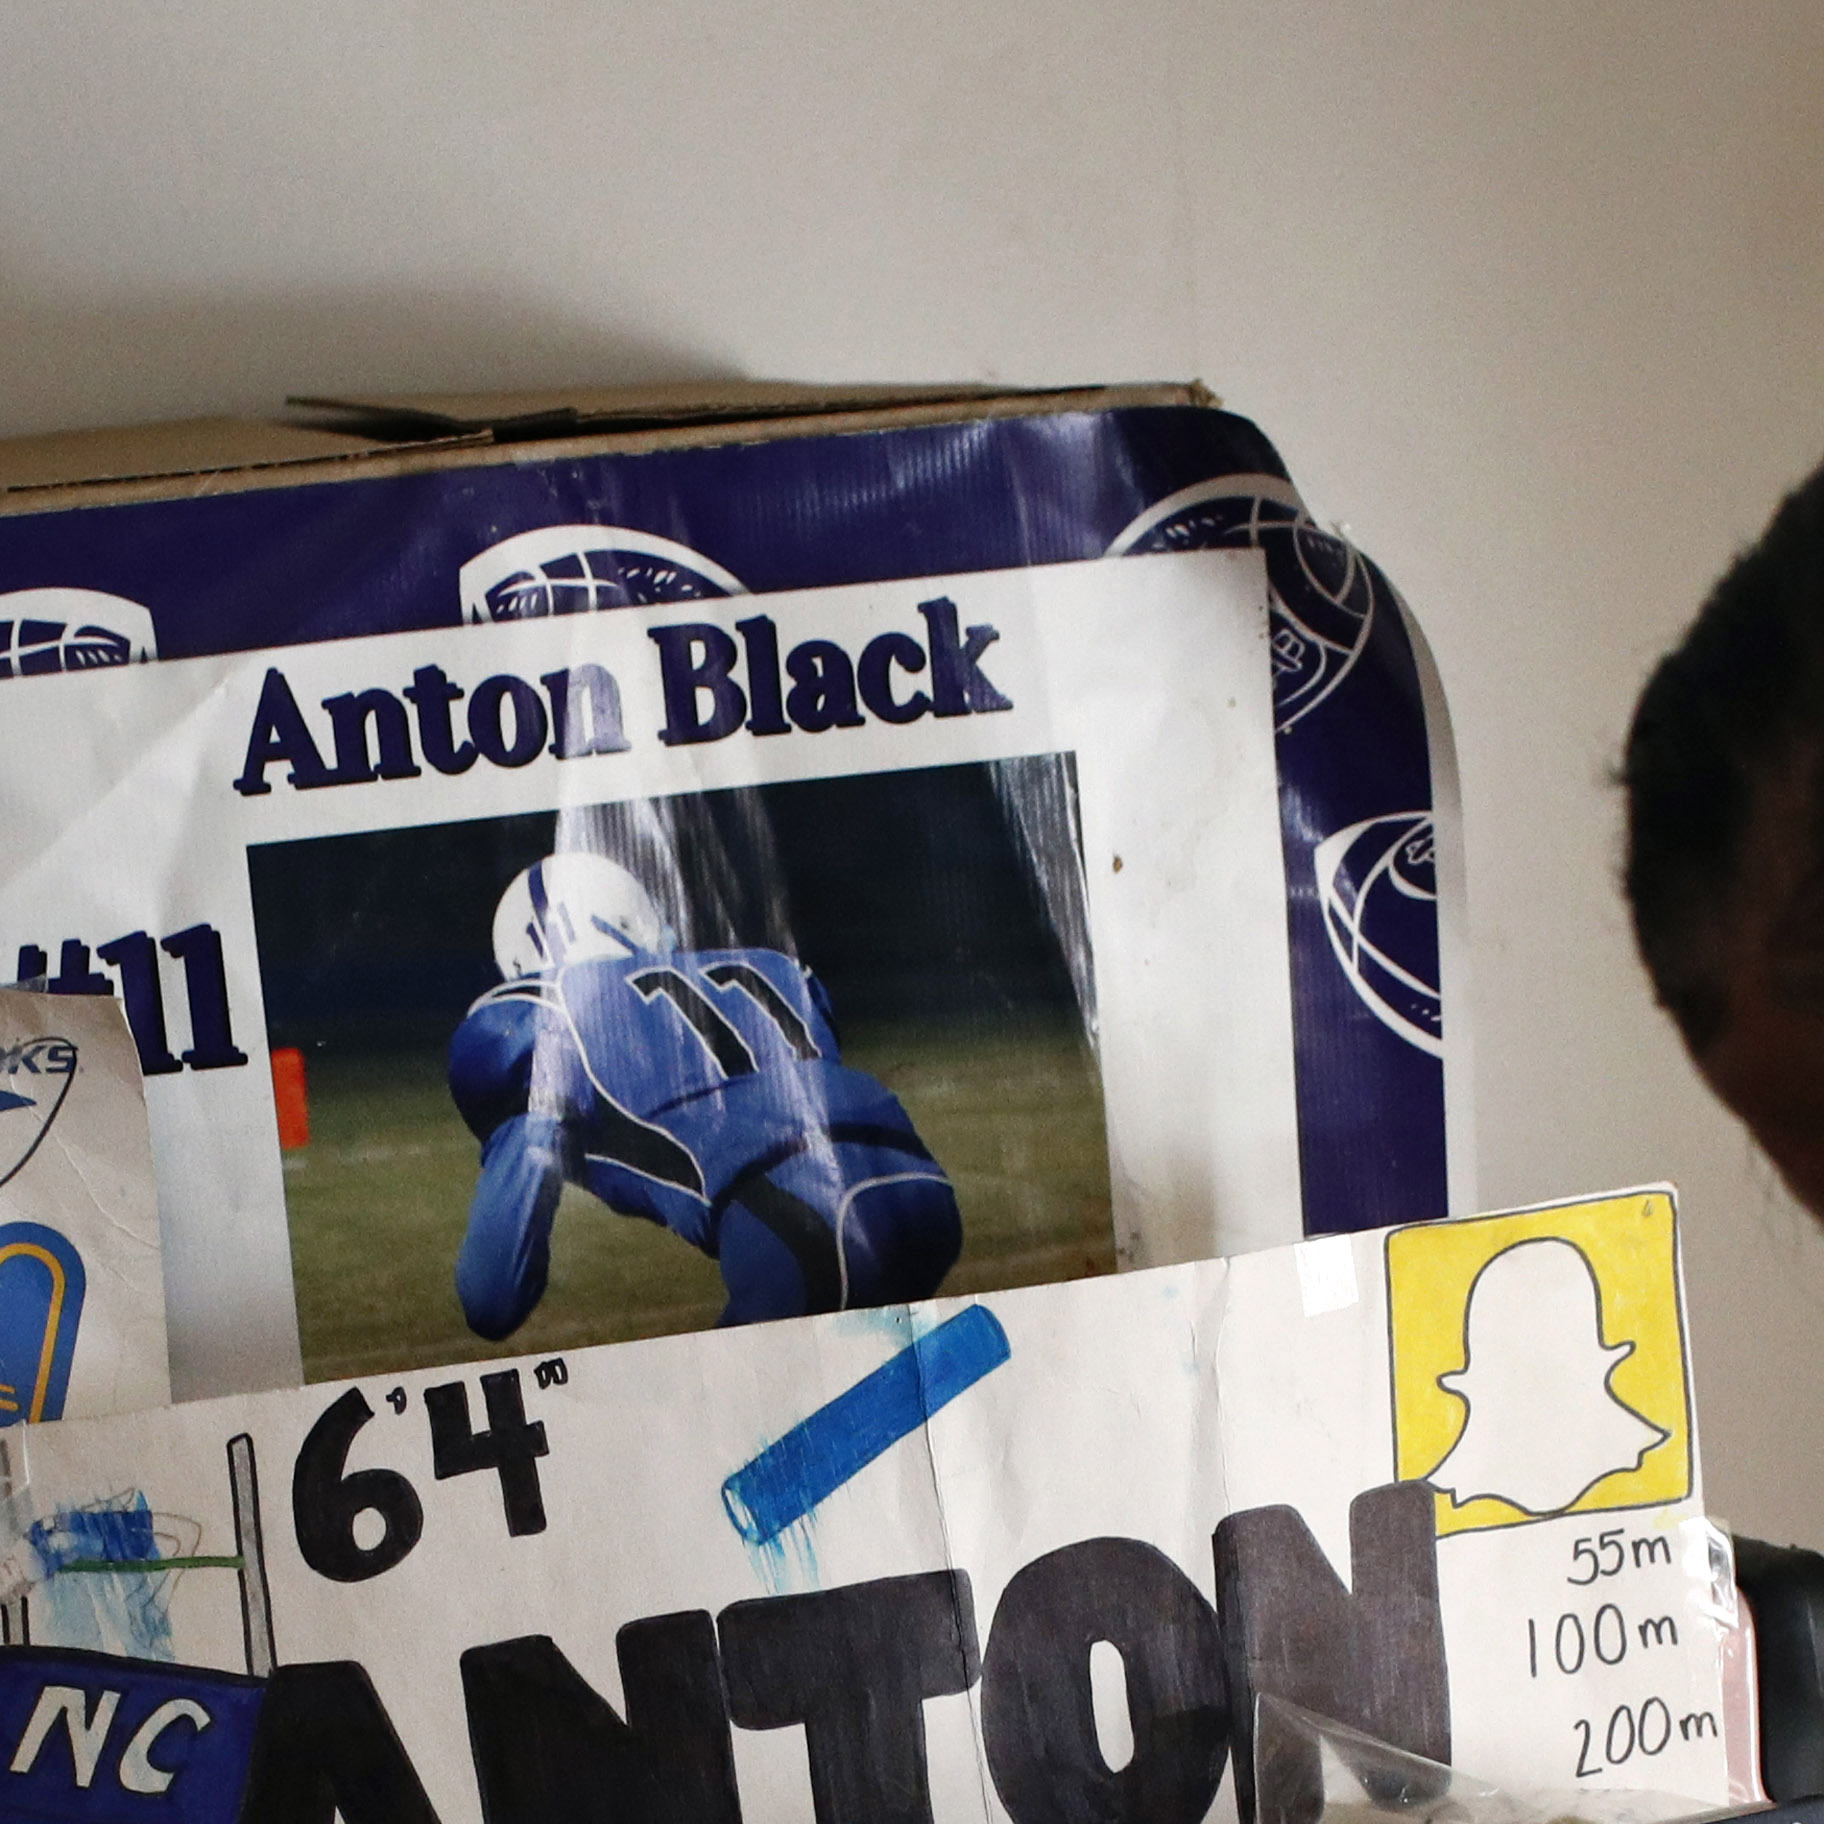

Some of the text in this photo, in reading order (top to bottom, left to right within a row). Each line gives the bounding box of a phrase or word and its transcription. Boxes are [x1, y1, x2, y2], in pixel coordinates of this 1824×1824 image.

[233, 596, 1013, 796] Anton Black
[1567, 1528, 1672, 1586] 55m
[9, 1685, 212, 1794] NC
